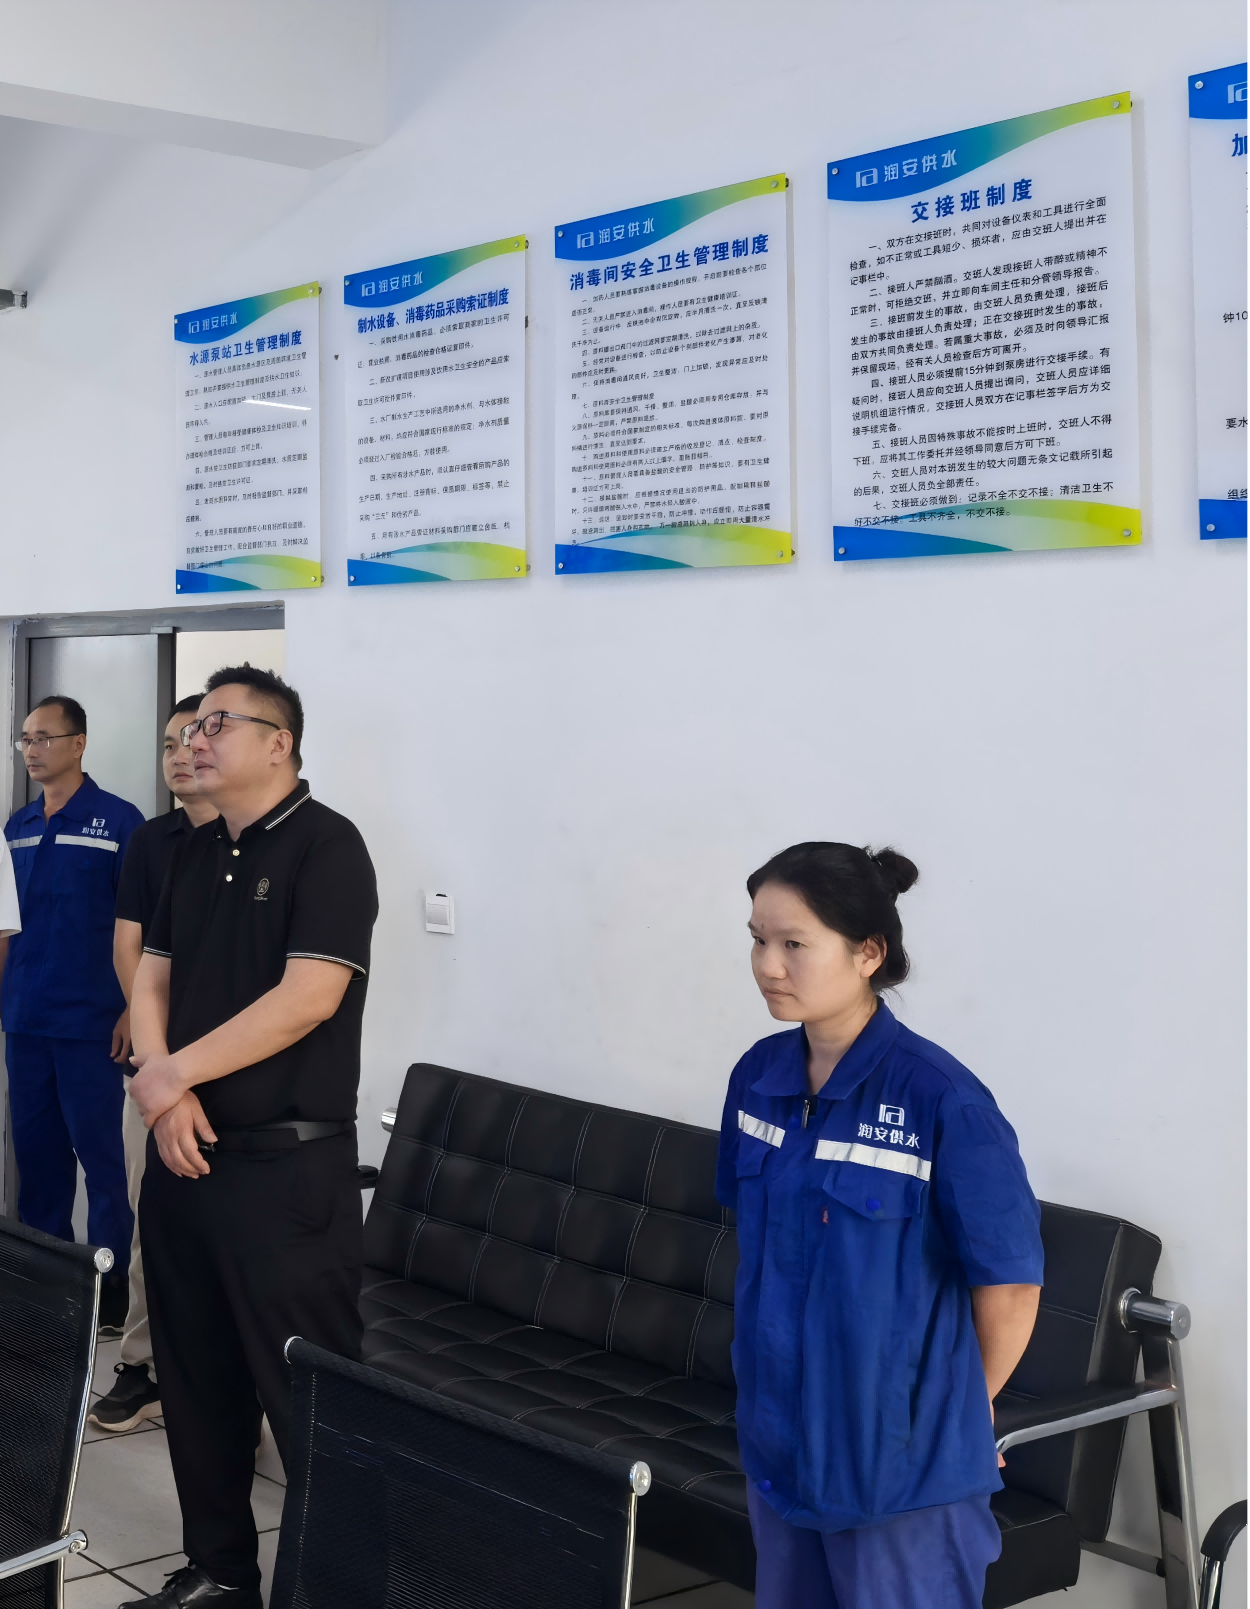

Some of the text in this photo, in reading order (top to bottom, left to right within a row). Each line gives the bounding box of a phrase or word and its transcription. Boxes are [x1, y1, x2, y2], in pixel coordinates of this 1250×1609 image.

[883, 149, 957, 182] 润安供水
[910, 176, 1033, 224] 交接班制度
[598, 216, 655, 244] 润安供水
[569, 231, 769, 291] 消毒间安全卫生管理制度
[378, 270, 423, 293] 润安供水
[357, 286, 509, 334] 制水设备、消毒药品采购索证制度
[189, 328, 301, 366] 水源泵站卫生管理制度
[858, 1123, 920, 1149] 润安供水
